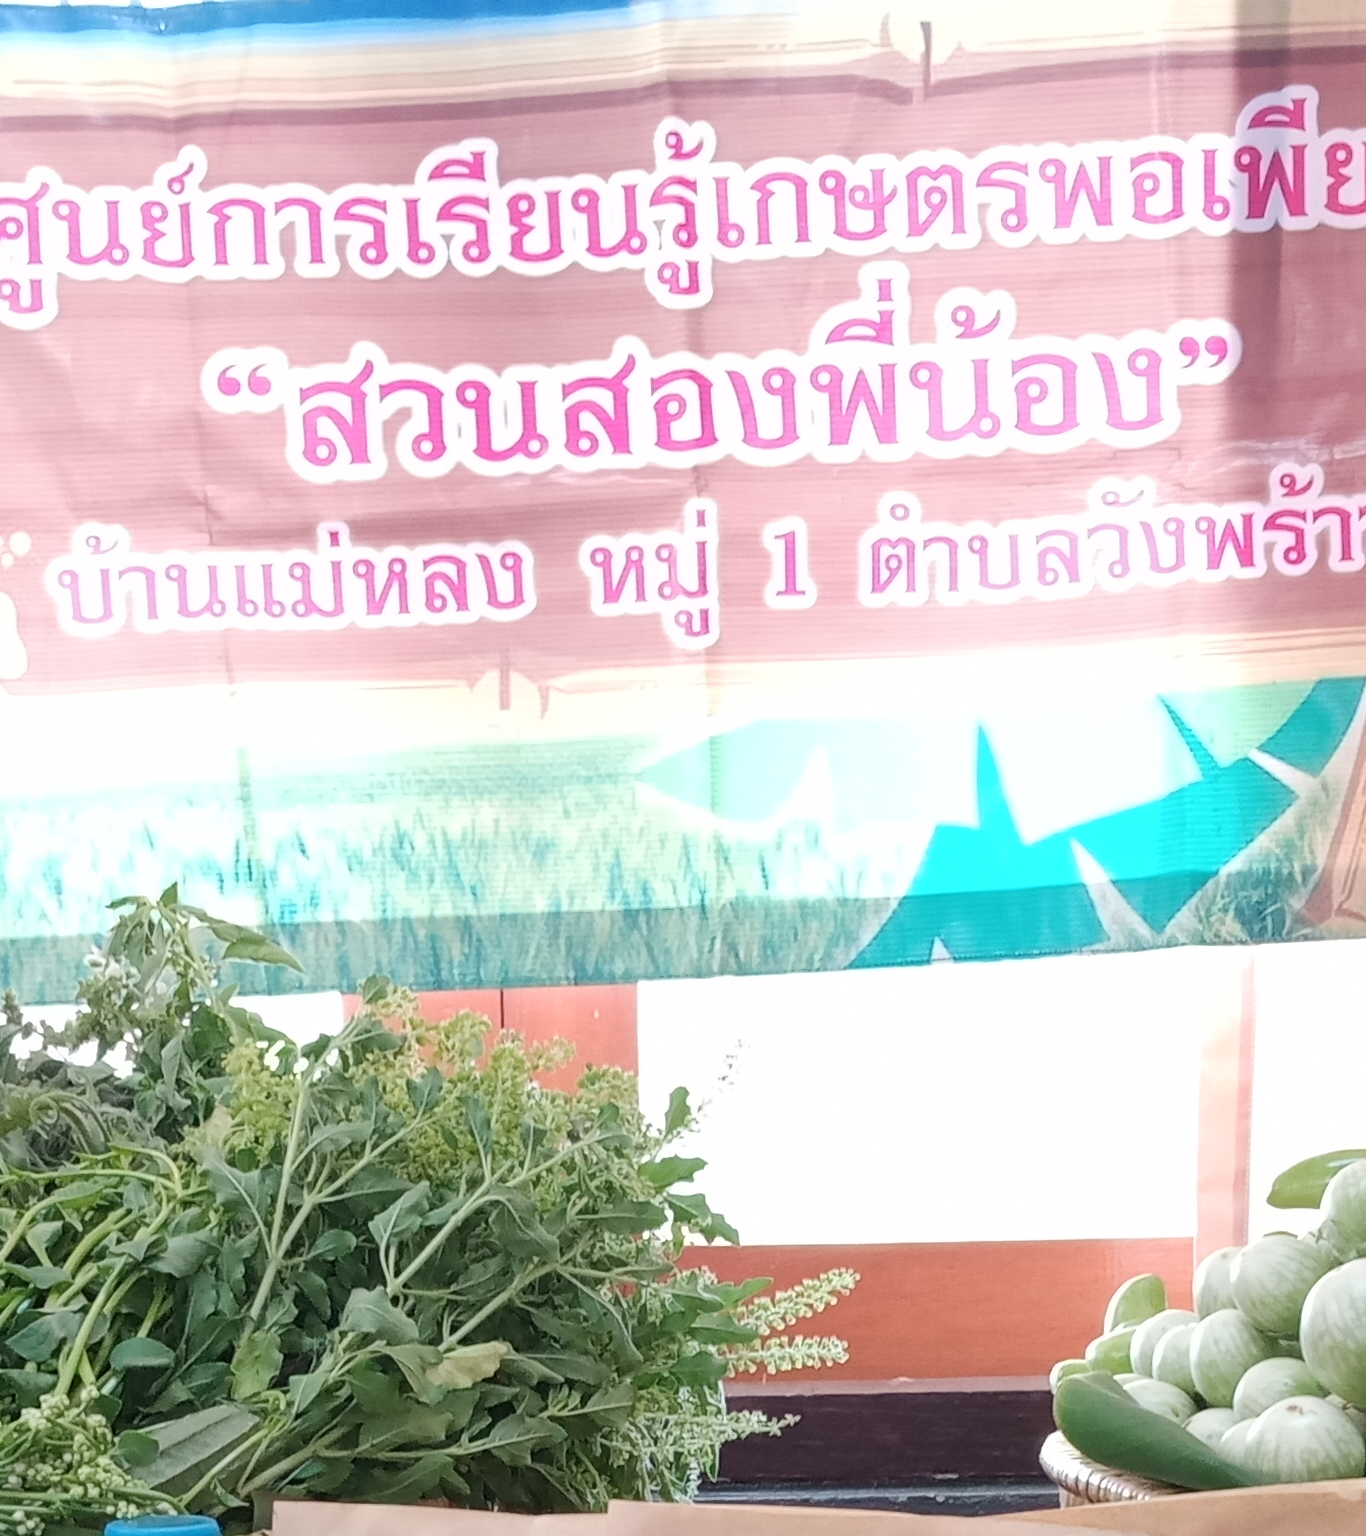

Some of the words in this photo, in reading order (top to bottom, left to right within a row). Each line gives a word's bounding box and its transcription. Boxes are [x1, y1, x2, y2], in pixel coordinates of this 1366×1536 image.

[213, 277, 1230, 468] “สวนสองพี่น้อง”
[55, 528, 528, 628] บ้านแม่หลง
[589, 508, 710, 638] หมู่
[771, 528, 810, 600] 1
